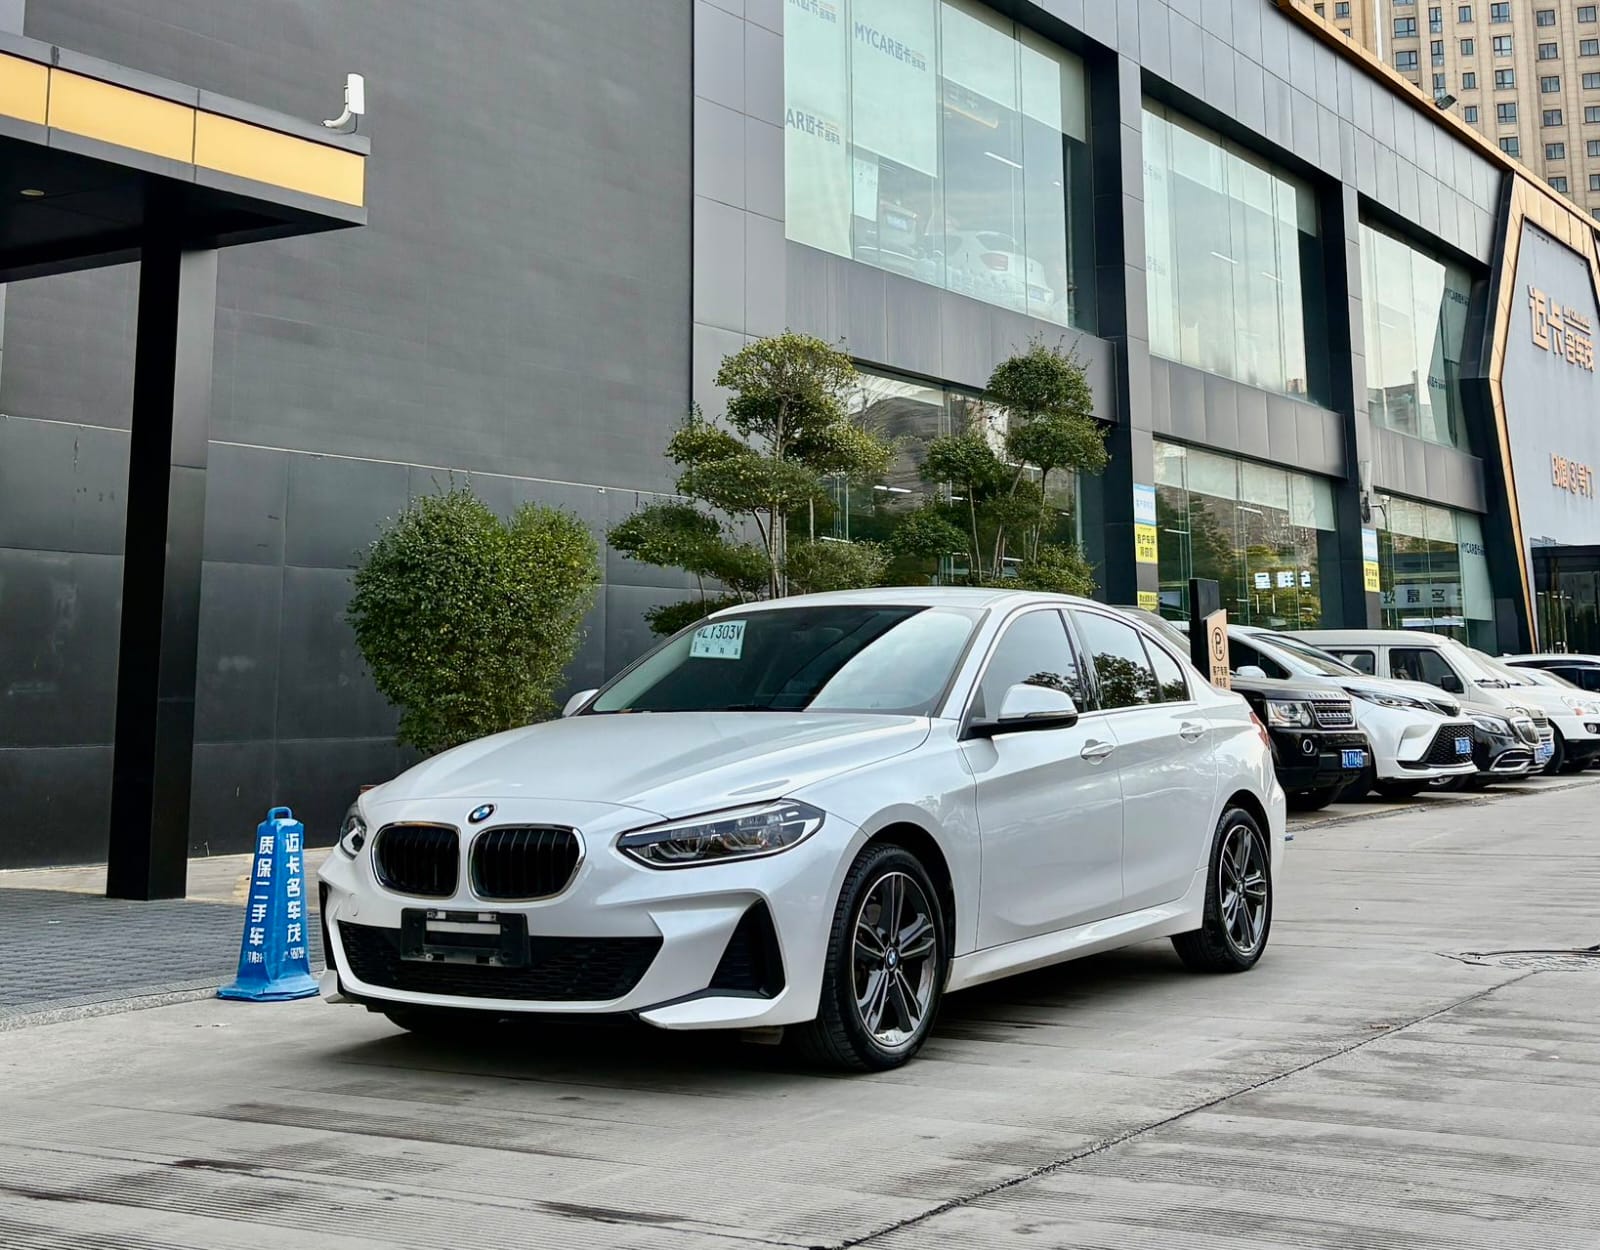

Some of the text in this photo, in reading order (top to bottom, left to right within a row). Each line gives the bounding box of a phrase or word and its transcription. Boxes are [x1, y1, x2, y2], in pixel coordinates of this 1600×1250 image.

[249, 835, 275, 946] 质保二手车
[285, 833, 301, 943] 迈卡名车茂
